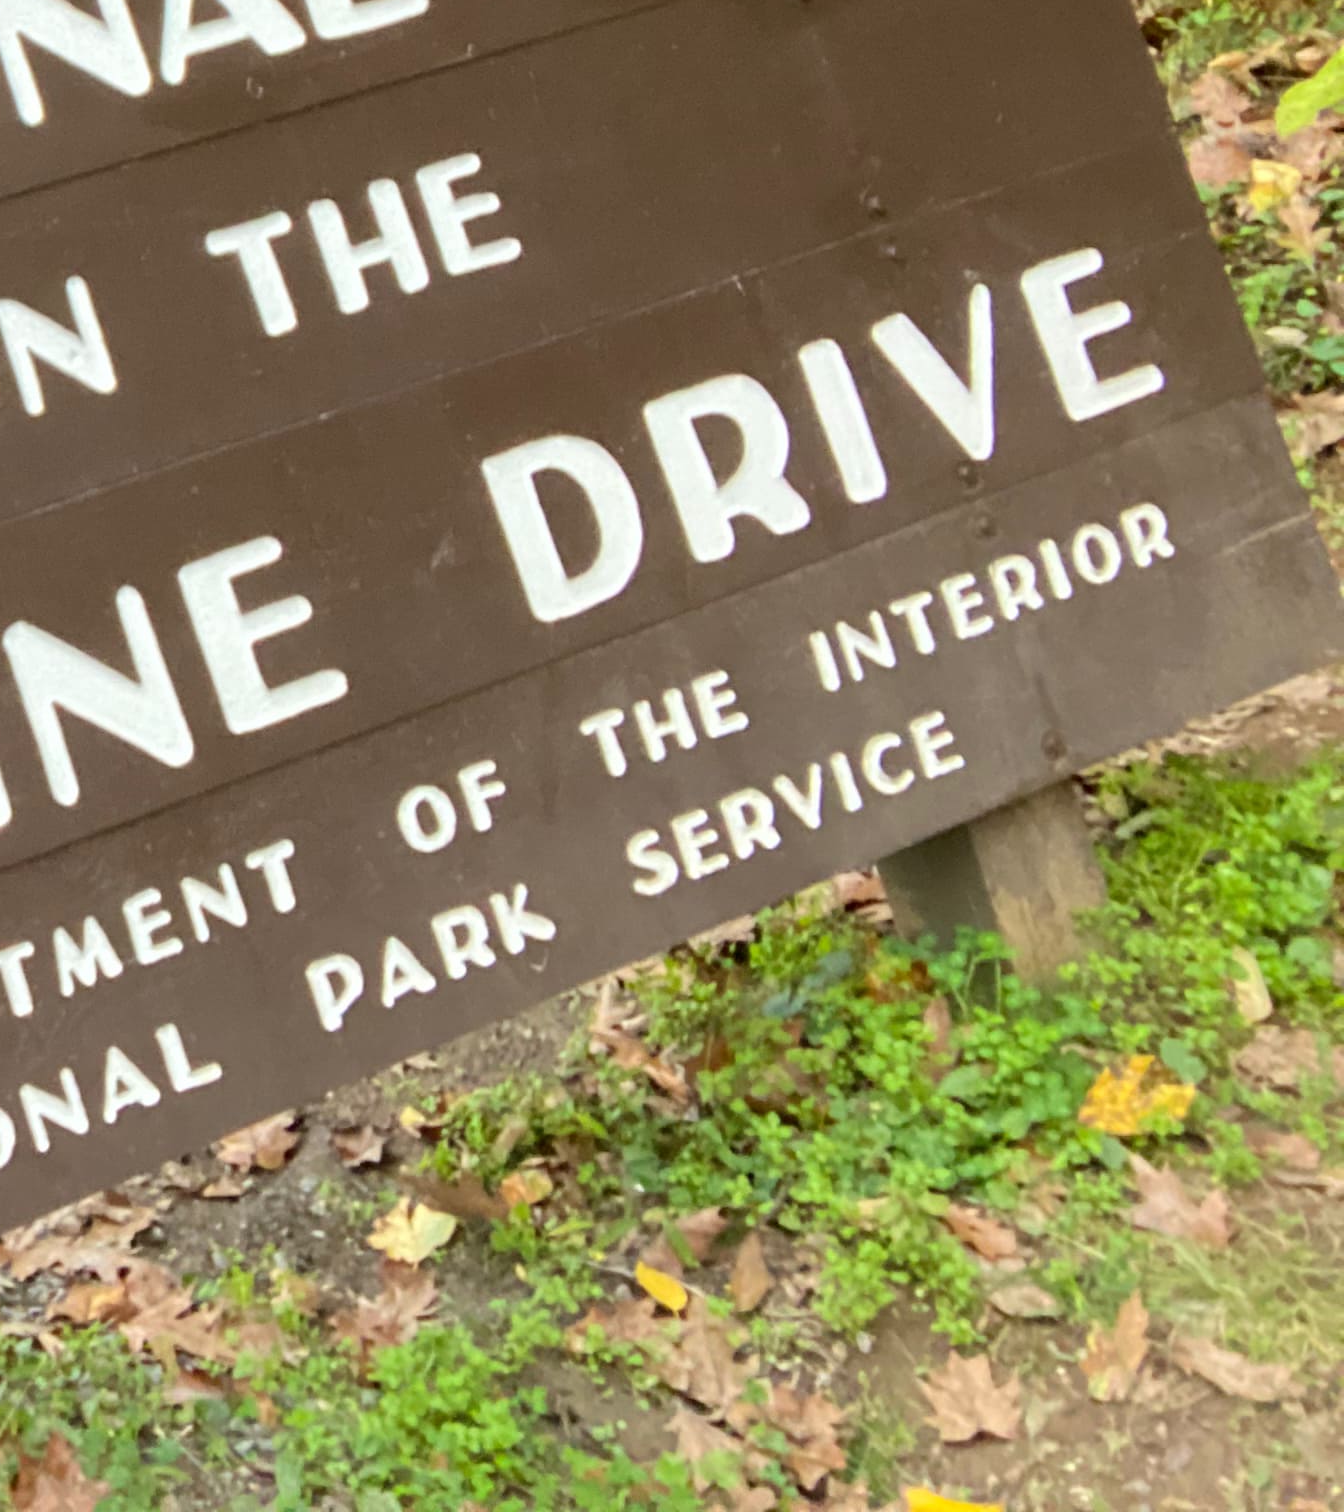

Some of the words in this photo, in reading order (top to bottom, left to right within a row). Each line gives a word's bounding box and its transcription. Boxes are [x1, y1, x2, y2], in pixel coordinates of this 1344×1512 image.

[204, 152, 523, 338] THE
[480, 247, 1165, 624] DRIVE
[396, 759, 507, 854] OF
[578, 669, 750, 778] THE
[808, 502, 1176, 693] INTERIOR
[304, 882, 558, 1034] PARK
[626, 710, 966, 897] SERVICE
